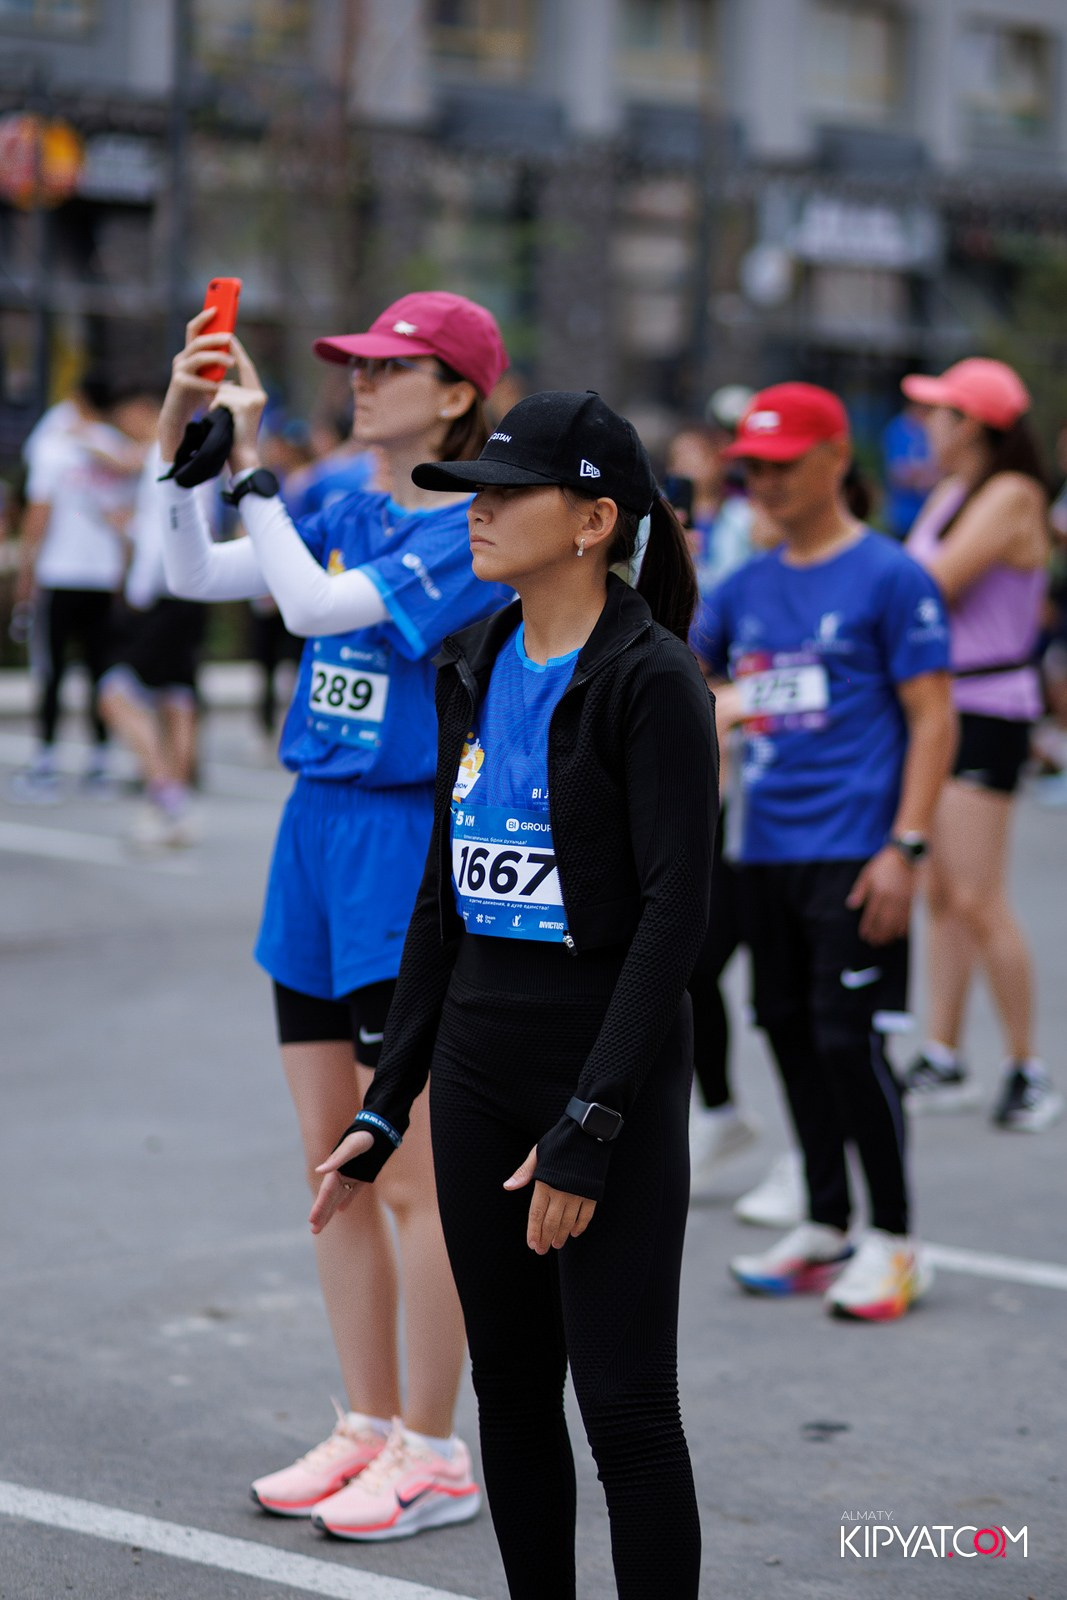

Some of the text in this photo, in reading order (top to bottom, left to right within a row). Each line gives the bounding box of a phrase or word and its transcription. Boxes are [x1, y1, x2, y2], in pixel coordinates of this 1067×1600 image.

[311, 671, 374, 712] 289
[455, 811, 476, 827] 5 KM
[458, 845, 559, 897] 1667
[538, 920, 565, 930] INVICTUS
